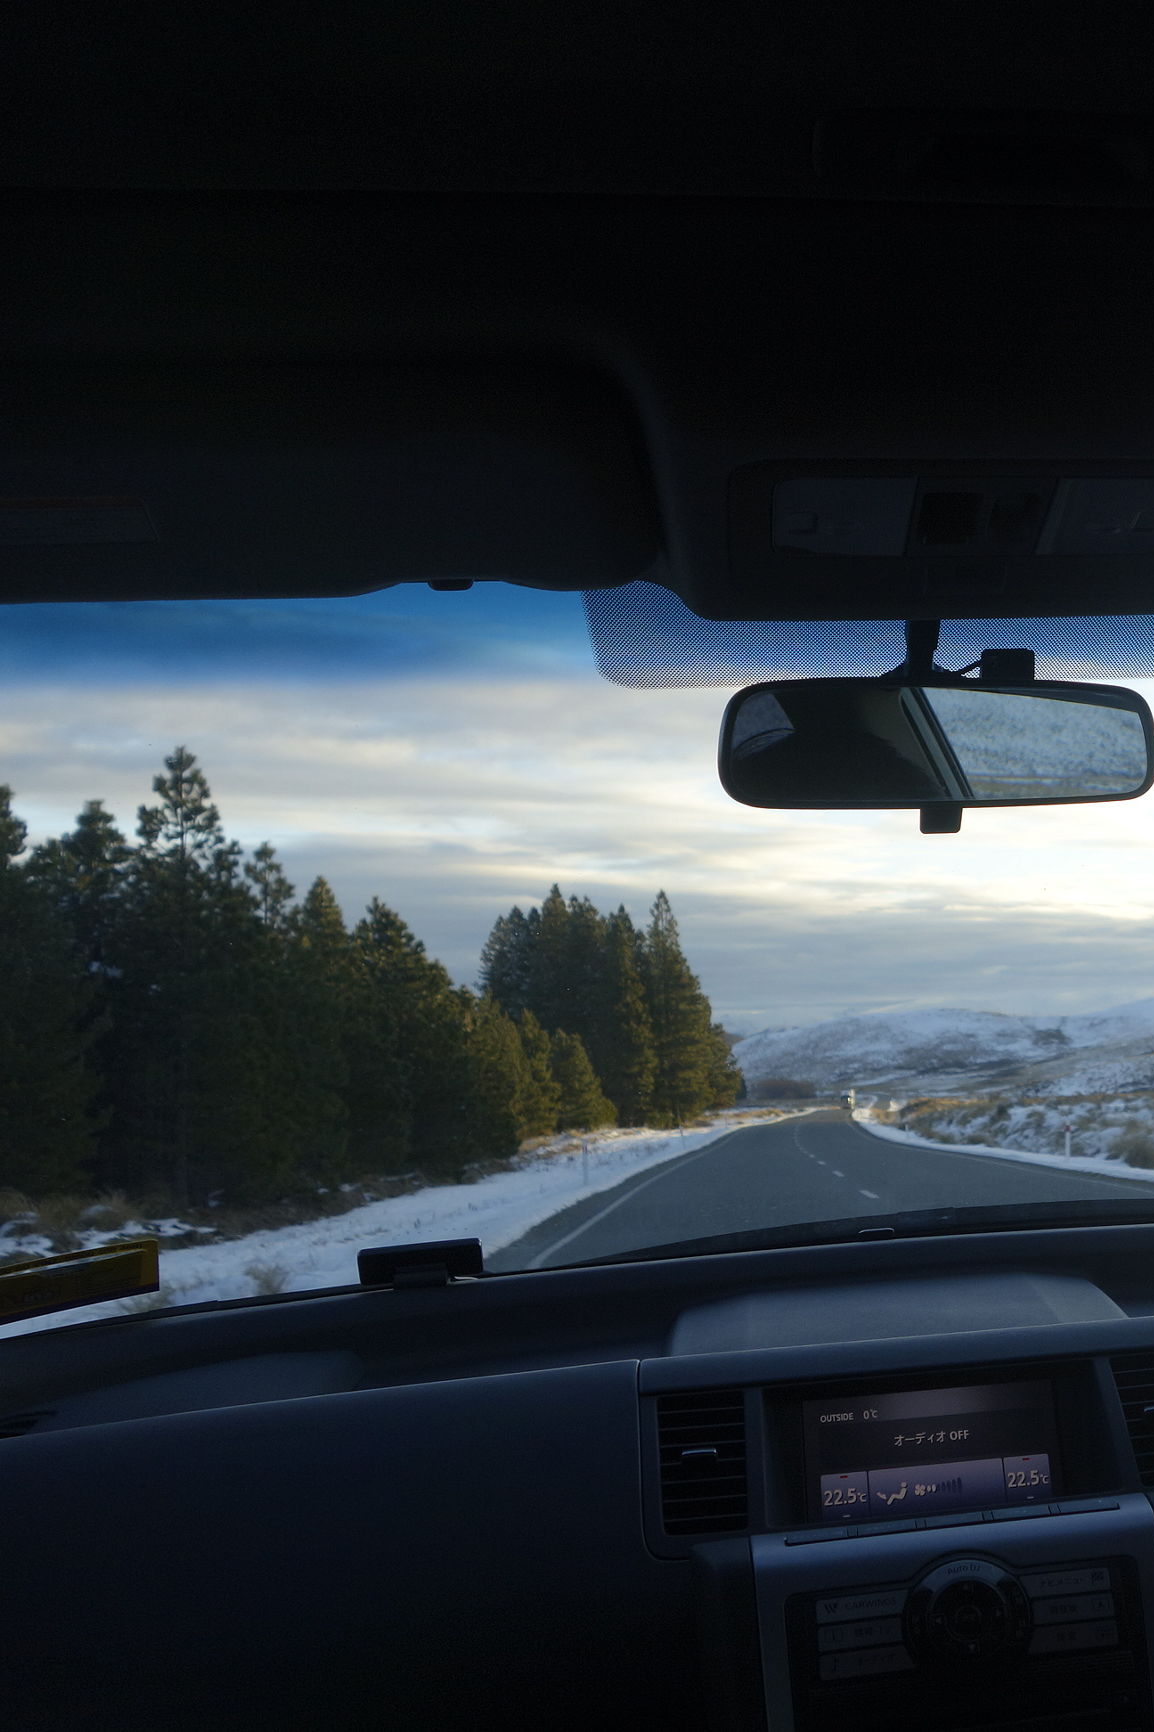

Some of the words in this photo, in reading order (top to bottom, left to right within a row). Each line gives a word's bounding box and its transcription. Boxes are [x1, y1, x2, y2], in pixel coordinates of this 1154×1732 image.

[819, 1412, 854, 1423] OUTSIDE
[894, 1430, 946, 1447] オーディオ
[949, 1429, 970, 1441] OFF
